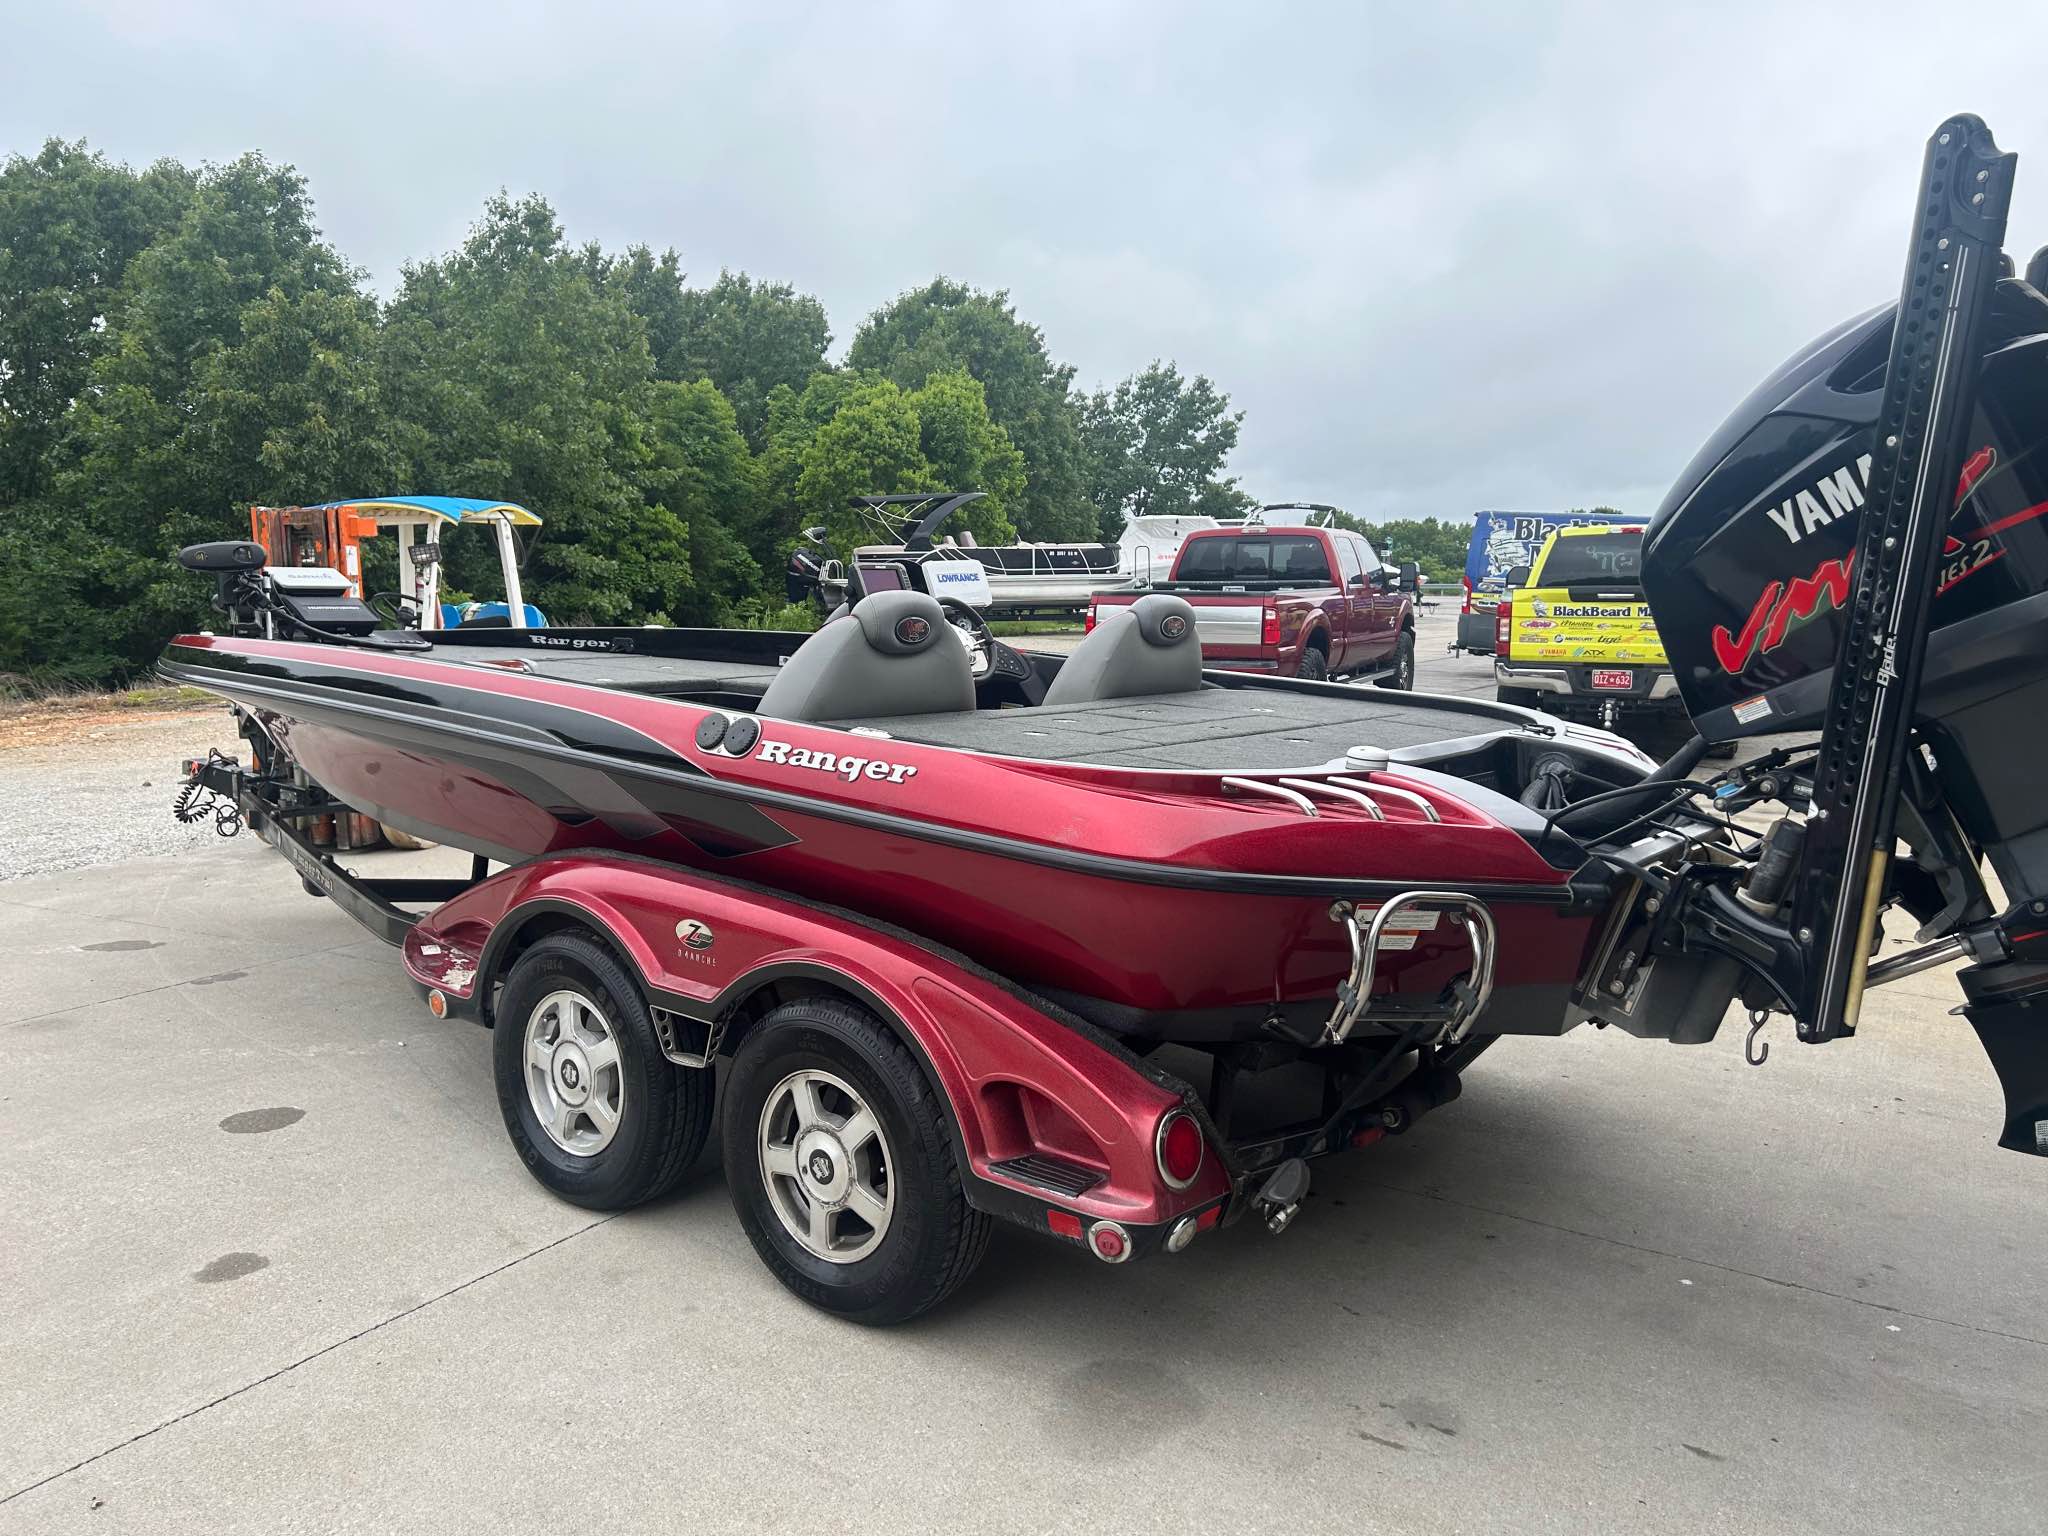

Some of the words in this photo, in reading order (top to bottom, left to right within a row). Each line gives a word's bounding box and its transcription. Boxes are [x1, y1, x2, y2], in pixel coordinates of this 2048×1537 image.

[1766, 453, 1873, 544] YAM
[1972, 539, 1993, 569] 2
[937, 573, 980, 583] LOWRANCE
[1553, 606, 1631, 617] BlackBeard
[1615, 675, 1630, 685] 632
[755, 740, 918, 784] Ranger
